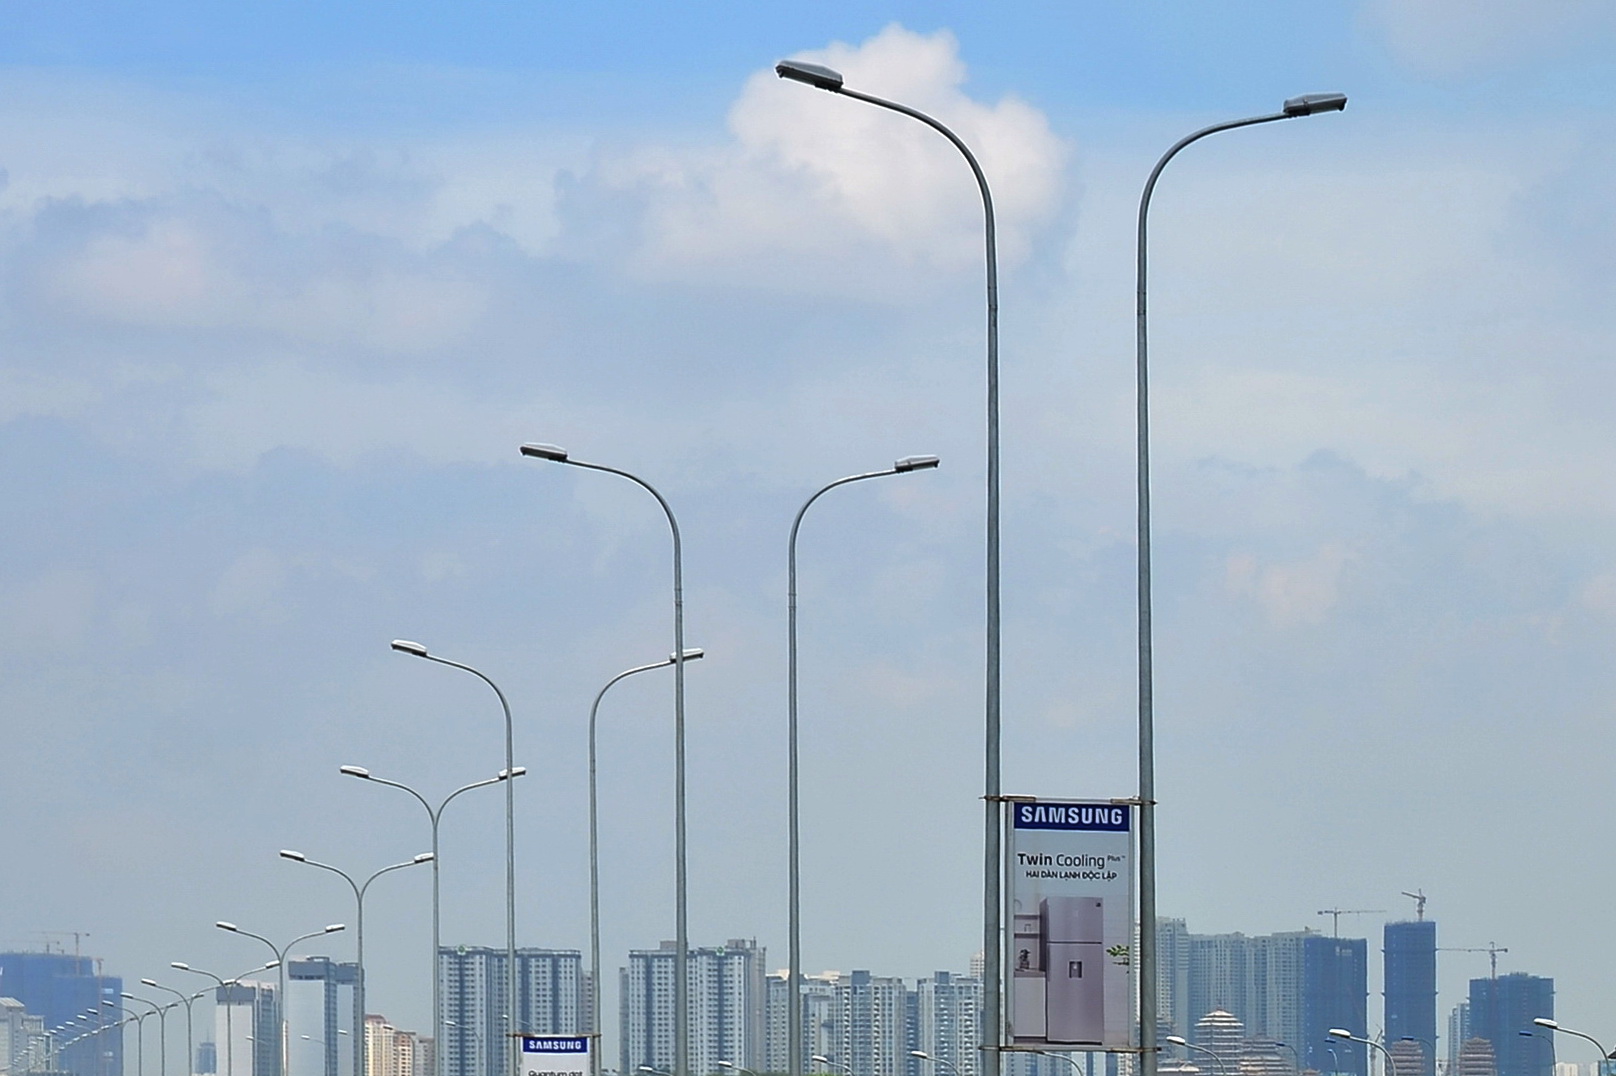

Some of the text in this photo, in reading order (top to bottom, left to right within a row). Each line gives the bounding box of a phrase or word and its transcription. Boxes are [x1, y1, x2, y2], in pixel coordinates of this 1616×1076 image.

[1021, 805, 1123, 825] SAMSUNG
[1017, 853, 1053, 866] Twin
[1056, 853, 1105, 870] Cooling
[1026, 870, 1040, 878] HAI
[528, 1039, 582, 1050] SAMSUNG
